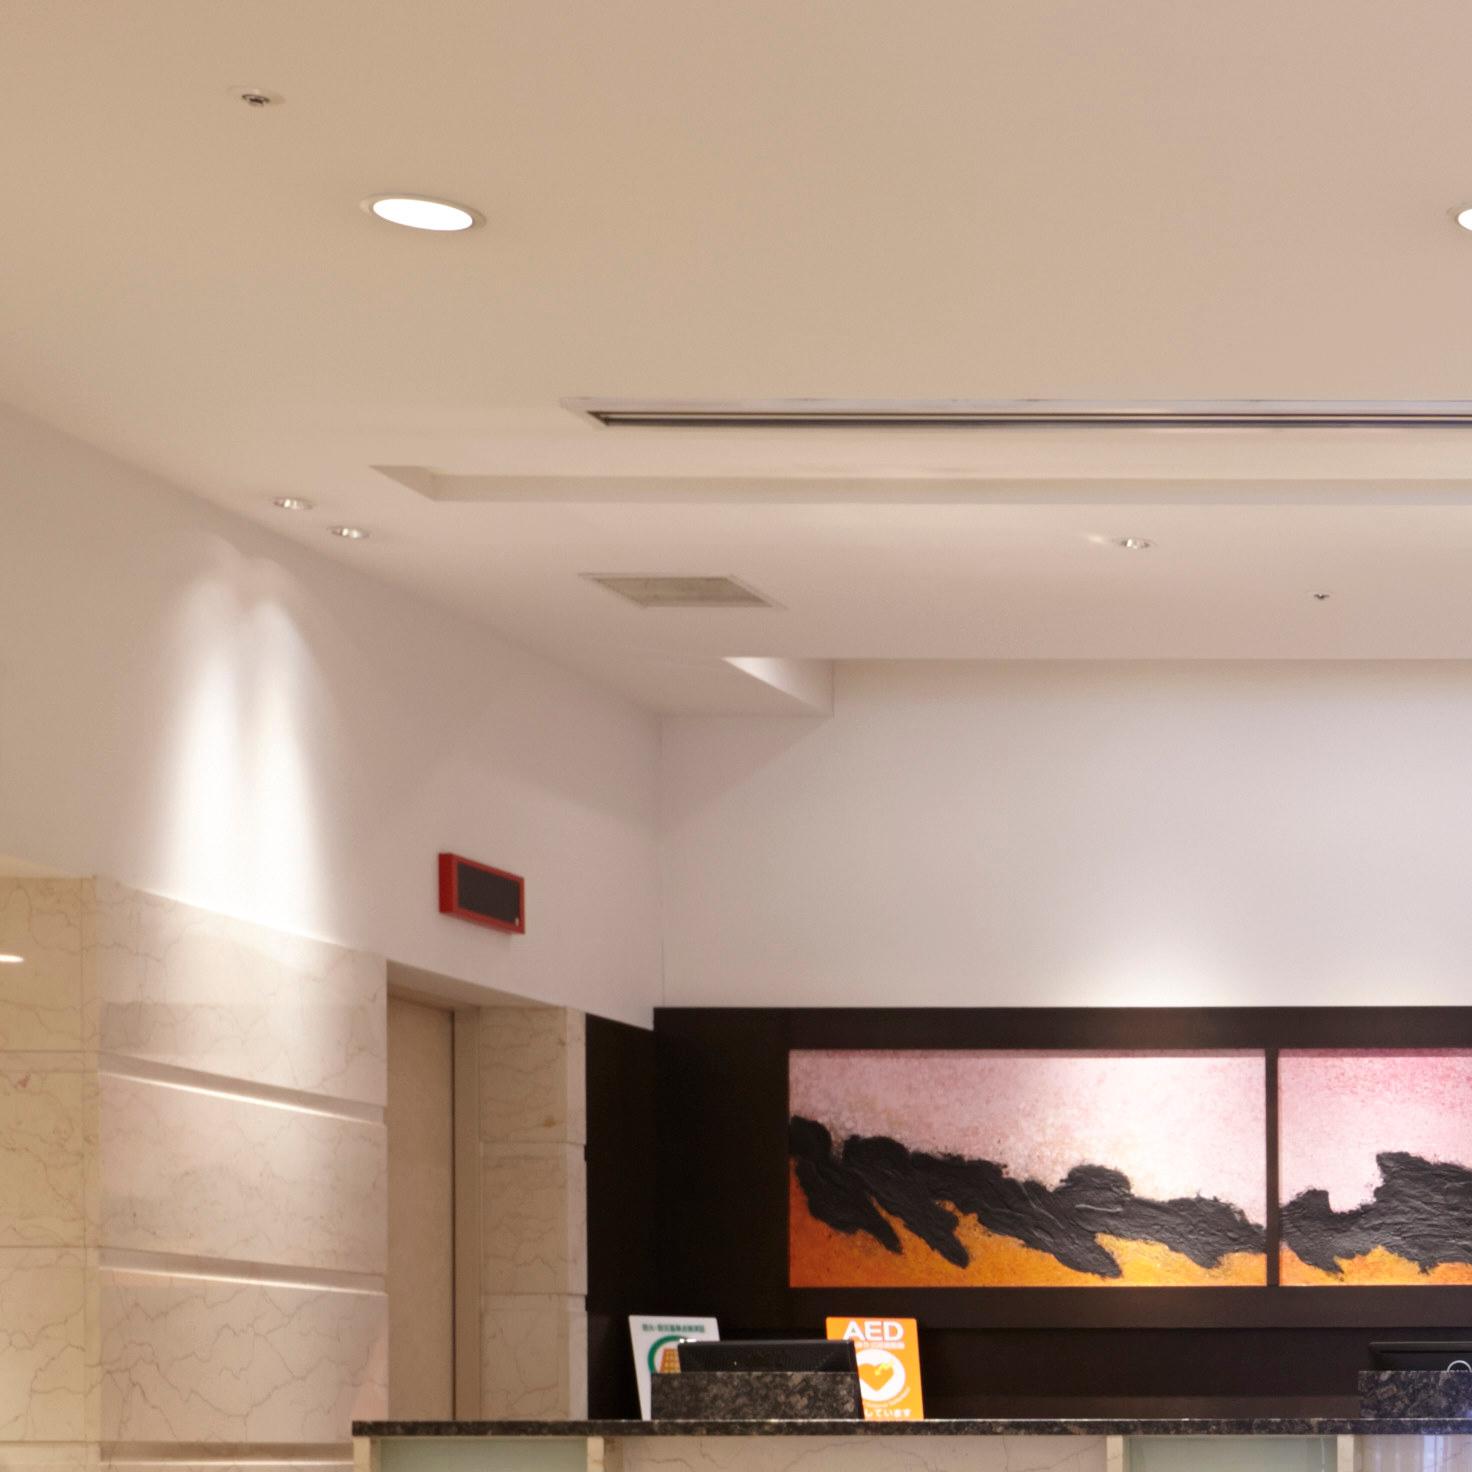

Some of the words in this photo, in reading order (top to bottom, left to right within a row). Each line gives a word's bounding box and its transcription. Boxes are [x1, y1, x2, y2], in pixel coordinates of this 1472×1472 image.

[843, 1320, 904, 1341] AED
[865, 1408, 911, 1418] しています
